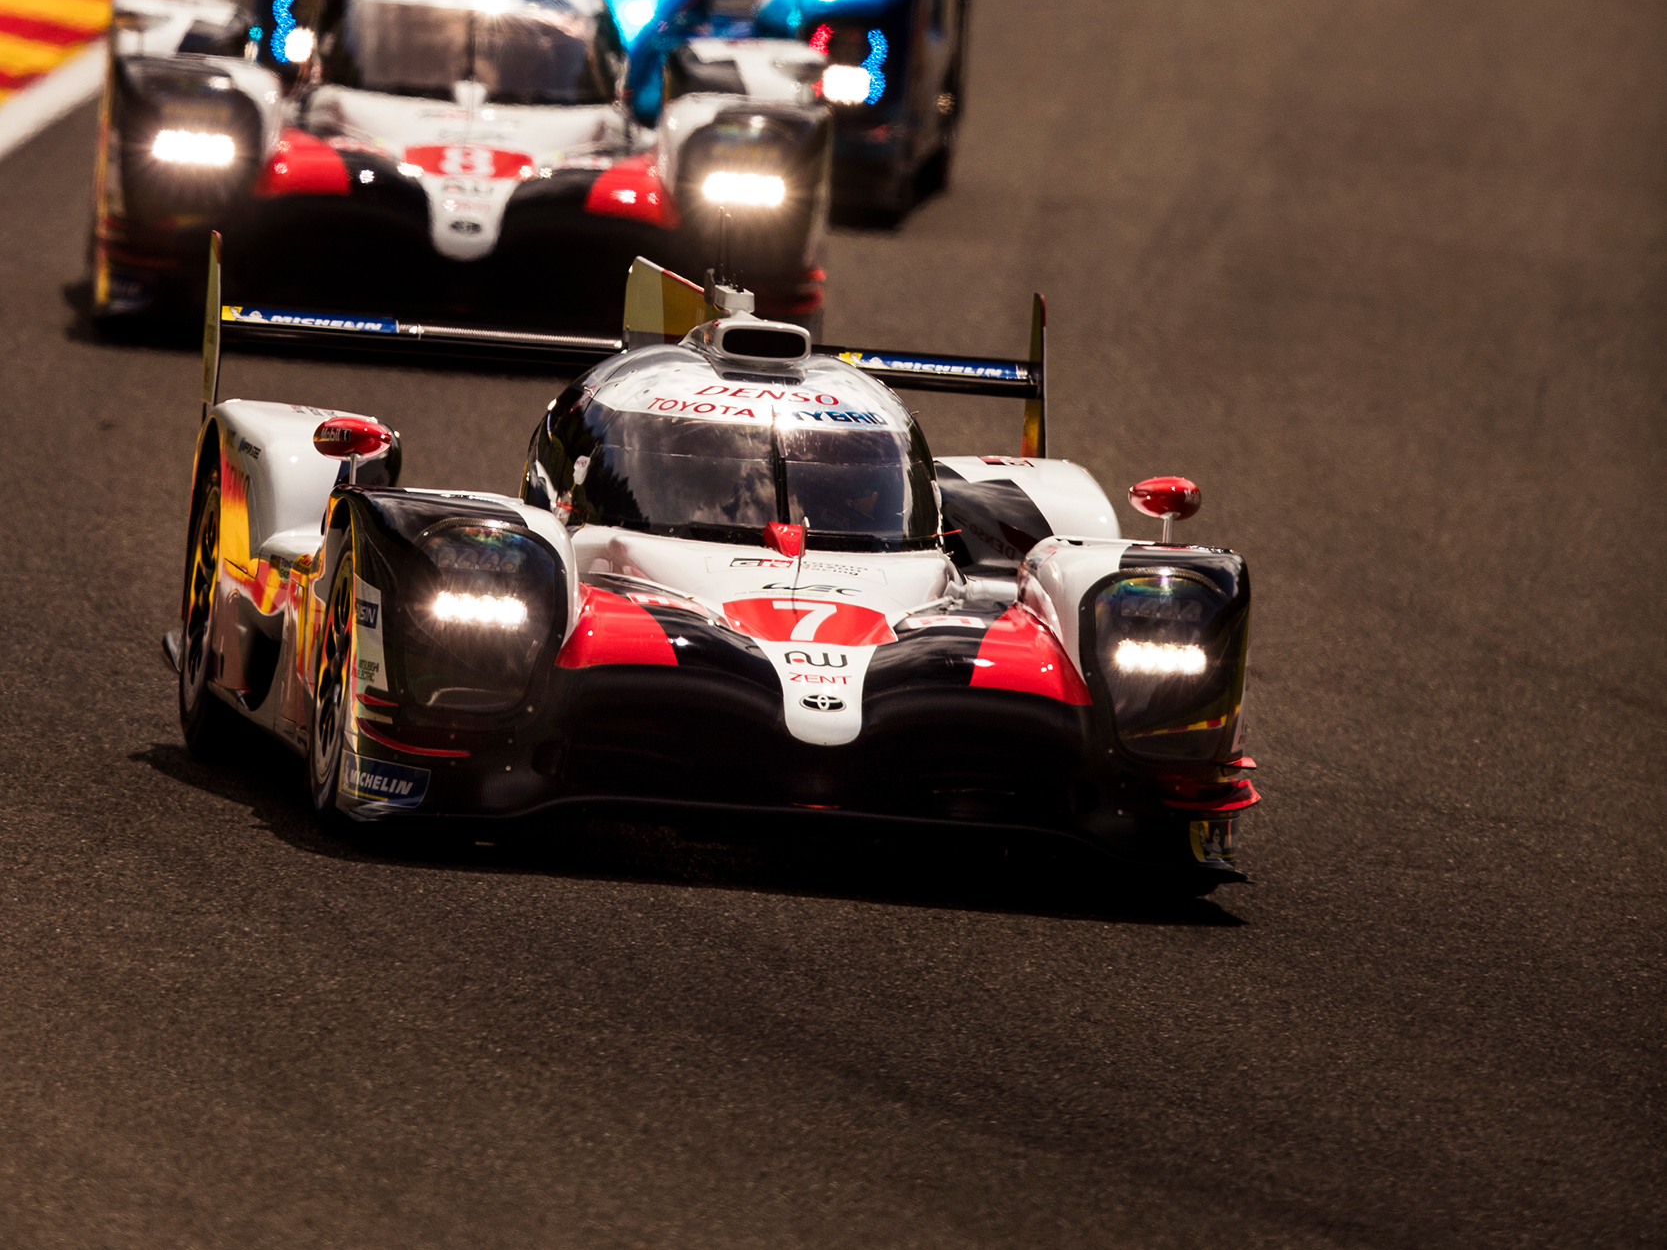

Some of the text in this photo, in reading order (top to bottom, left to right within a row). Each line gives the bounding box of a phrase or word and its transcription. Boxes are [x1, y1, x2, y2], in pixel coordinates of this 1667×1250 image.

[440, 146, 495, 177] 8
[271, 315, 383, 331] MICHELIN
[890, 360, 1003, 377] MICHELIN
[695, 385, 840, 406] DENSO
[647, 397, 756, 418] TOYOTA
[321, 428, 341, 441] Mobil
[772, 600, 838, 641] 7
[789, 671, 852, 685] ZENT
[349, 769, 414, 796] MICHELIN
